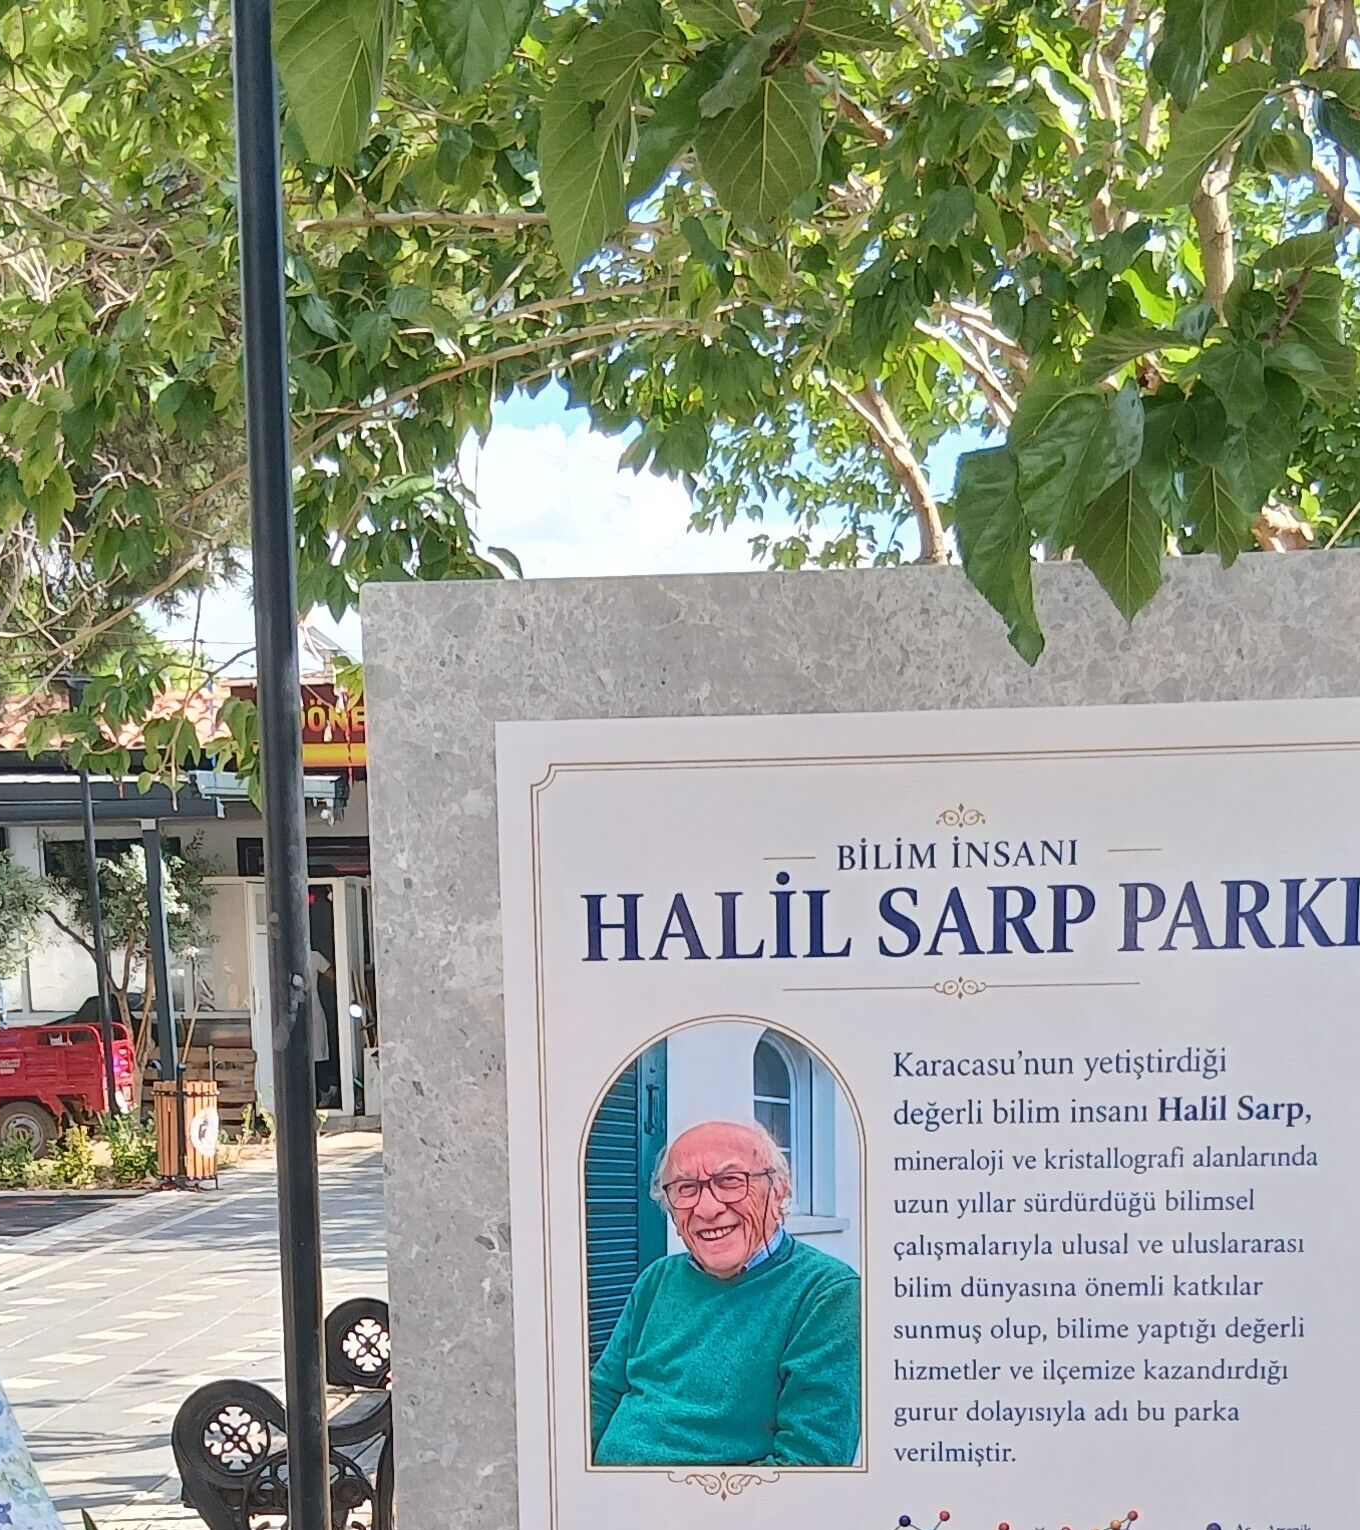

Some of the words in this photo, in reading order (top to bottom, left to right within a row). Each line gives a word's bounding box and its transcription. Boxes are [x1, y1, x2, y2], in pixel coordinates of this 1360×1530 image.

[301, 698, 365, 732] ÖNE
[837, 837, 937, 871] BİLİM
[952, 835, 1078, 869] İNSANI
[580, 871, 852, 962] HALİL
[878, 884, 1096, 958] SARP
[1083, 1046, 1226, 1082] yetiştirdiği
[893, 1098, 983, 1133] değerli
[992, 1098, 1060, 1125] bilim
[1070, 1098, 1148, 1123] insanı
[1158, 1094, 1227, 1122] Halil
[1237, 1095, 1312, 1128] Sarp,
[894, 1148, 1004, 1177] mineraloji
[1012, 1155, 1037, 1170] ve
[1044, 1145, 1184, 1175] kristallografi
[1192, 1144, 1318, 1168] alanlarında
[893, 1199, 949, 1214] uzun
[957, 1191, 1017, 1220] yıllar
[1023, 1189, 1156, 1218] sürdürdüğü
[1165, 1188, 1254, 1212] bilimsel
[893, 1233, 1053, 1262] çalışmalarıyla
[1061, 1232, 1129, 1255] ulusal
[1137, 1239, 1164, 1254] ve
[1172, 1231, 1304, 1254] uluslararası
[894, 1275, 952, 1298] bilim
[960, 1275, 1077, 1303] dünyasına
[1085, 1274, 1163, 1297] önemli
[1173, 1274, 1264, 1297] katkılar
[893, 1324, 982, 1345] sunmuş
[990, 1317, 1048, 1345] olup,
[1056, 1316, 1129, 1339] bilime
[1136, 1318, 1217, 1345] yaptığı
[1225, 1315, 1305, 1344] değerli
[894, 1358, 1002, 1381] hizmetler
[1009, 1365, 1034, 1381] ve
[1043, 1358, 1136, 1385] ilçemize
[1143, 1357, 1288, 1386] kazandırdığı
[893, 1407, 959, 1428] gurur
[966, 1399, 1086, 1428] dolayısıyla
[1094, 1399, 1128, 1422] adı
[1137, 1399, 1165, 1422] bu
[1174, 1399, 1240, 1428] parka
[893, 1440, 1016, 1468] verilmiştir.
